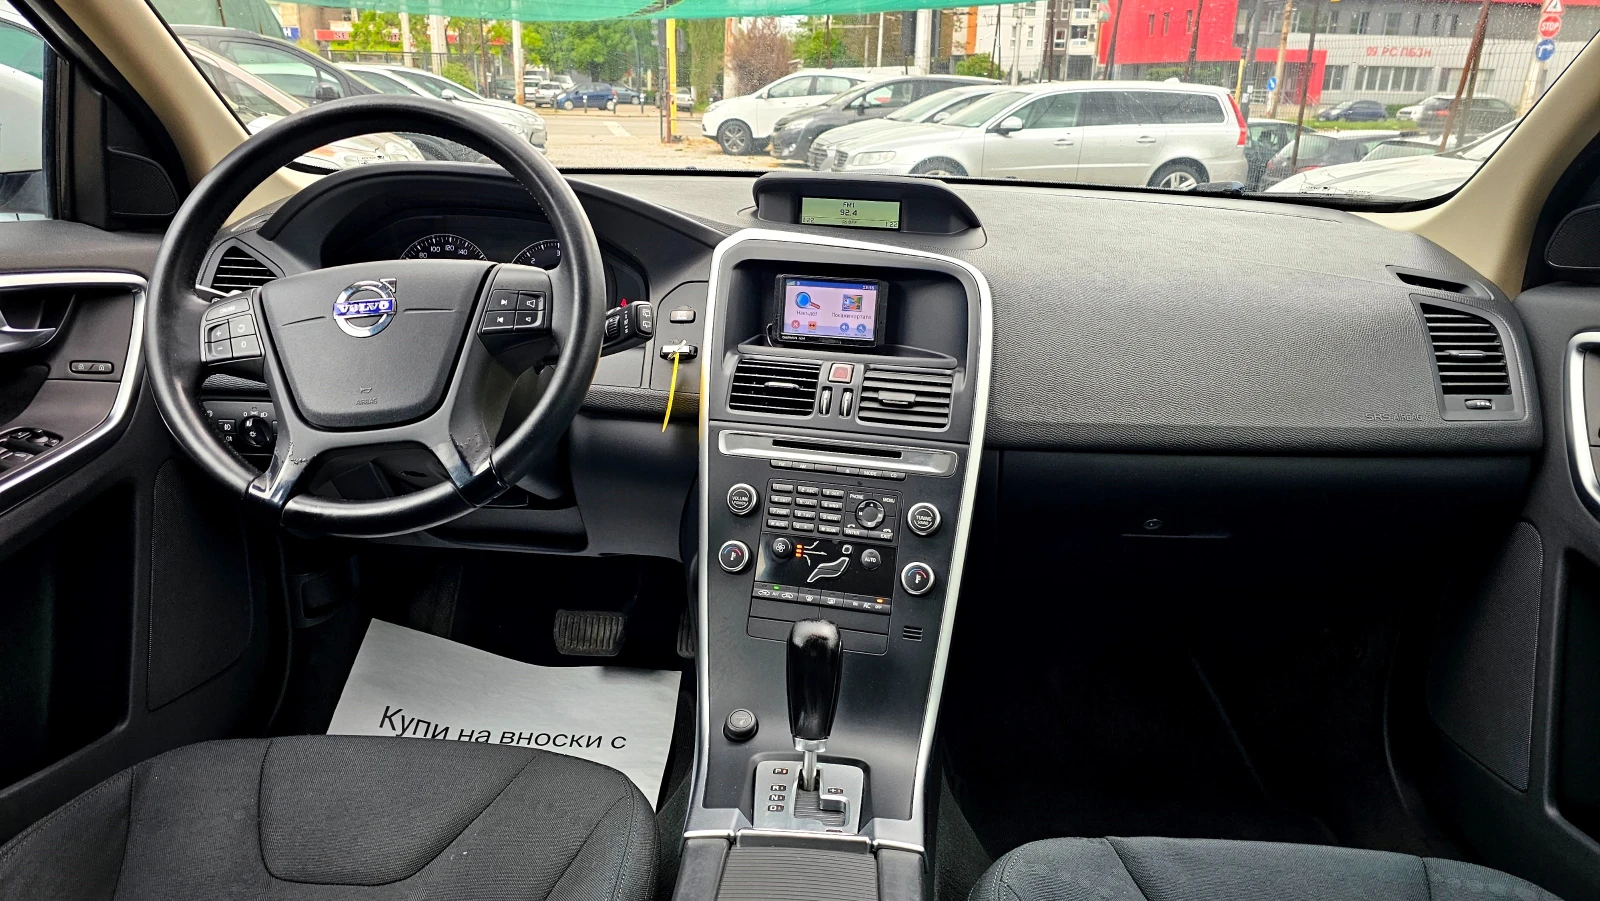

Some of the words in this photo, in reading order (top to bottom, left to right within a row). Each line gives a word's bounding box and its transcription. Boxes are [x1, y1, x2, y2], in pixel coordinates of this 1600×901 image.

[1541, 22, 1559, 31] STOP
[1366, 46, 1378, 56] 09
[1381, 46, 1398, 57] РС
[337, 301, 390, 313] VOLVO
[1365, 413, 1390, 421] SRS
[379, 705, 450, 741] Купи
[457, 728, 491, 744] на
[499, 731, 603, 748] вноски
[610, 736, 627, 749] с
